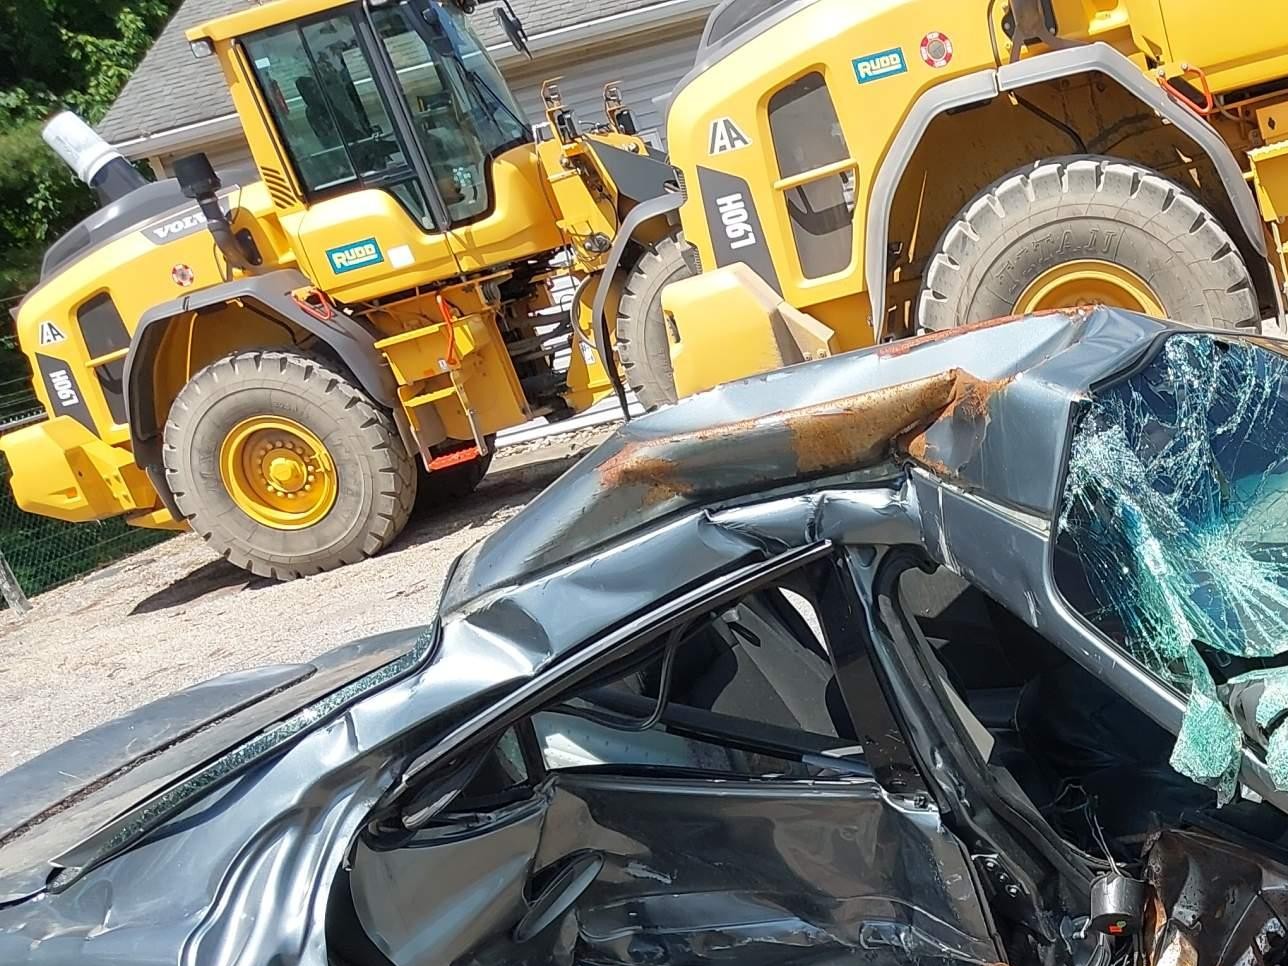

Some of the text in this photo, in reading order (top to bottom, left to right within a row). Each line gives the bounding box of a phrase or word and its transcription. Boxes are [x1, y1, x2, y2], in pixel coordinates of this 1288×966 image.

[857, 53, 902, 79] RUDD
[153, 211, 208, 238] VOLV
[716, 192, 757, 250] L90H
[331, 243, 378, 269] RUDD
